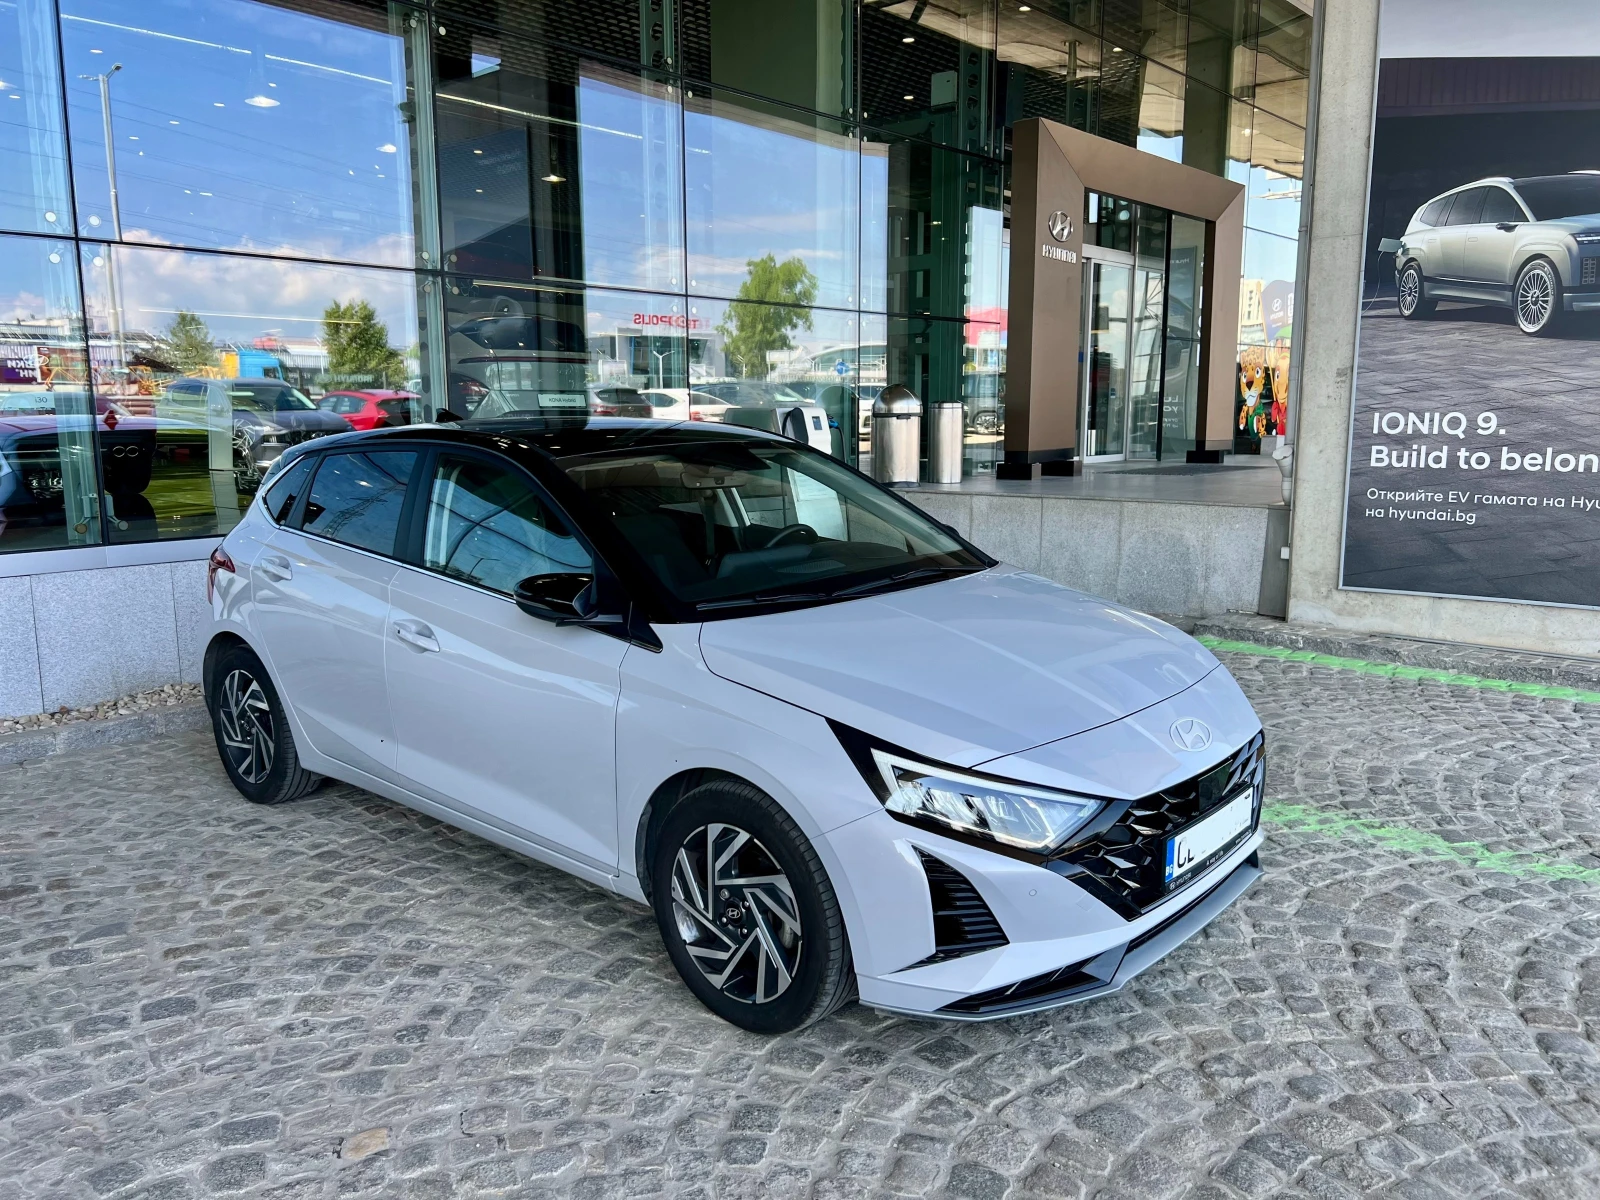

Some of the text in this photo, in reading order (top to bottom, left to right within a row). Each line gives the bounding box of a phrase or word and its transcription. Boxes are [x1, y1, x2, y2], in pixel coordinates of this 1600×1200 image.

[1042, 244, 1077, 264] HYUNDAI
[1372, 411, 1506, 439] IONIQ 9.
[1370, 444, 1599, 472] Build to belon
[1366, 487, 1444, 503] Открийте
[1448, 490, 1471, 503] EV
[1474, 494, 1538, 506] гамата
[1542, 497, 1566, 508] на
[1365, 506, 1477, 525] на hyundai.bg
